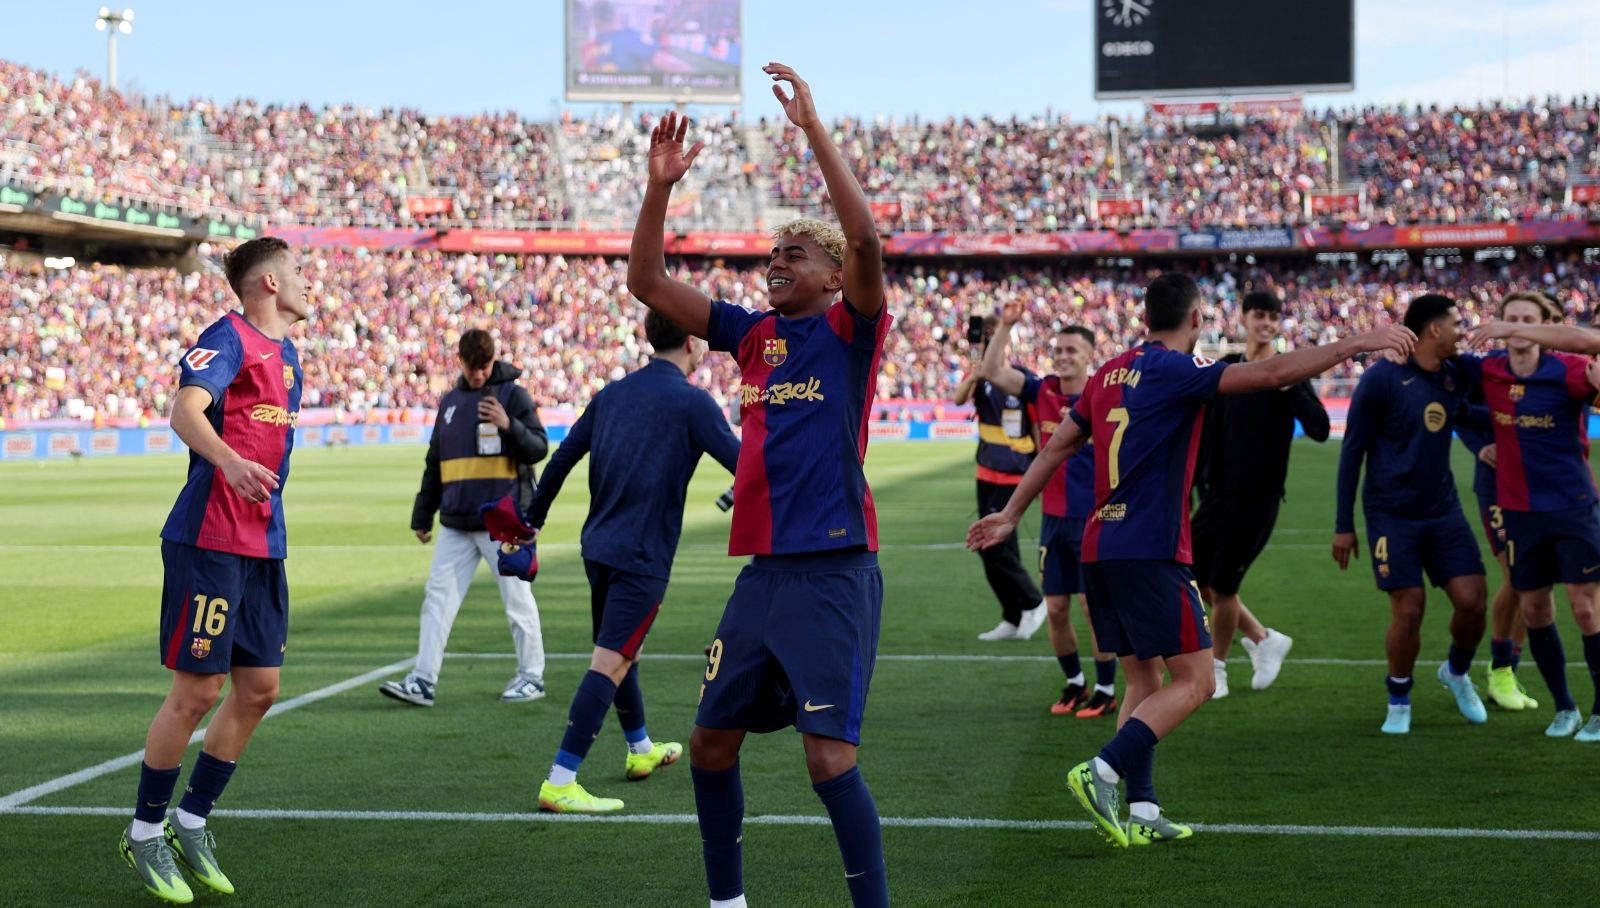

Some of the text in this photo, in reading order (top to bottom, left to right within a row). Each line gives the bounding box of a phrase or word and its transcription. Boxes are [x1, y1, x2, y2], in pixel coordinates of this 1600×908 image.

[1106, 407, 1130, 489] 7
[1375, 536, 1388, 562] 4
[193, 593, 229, 636] 16
